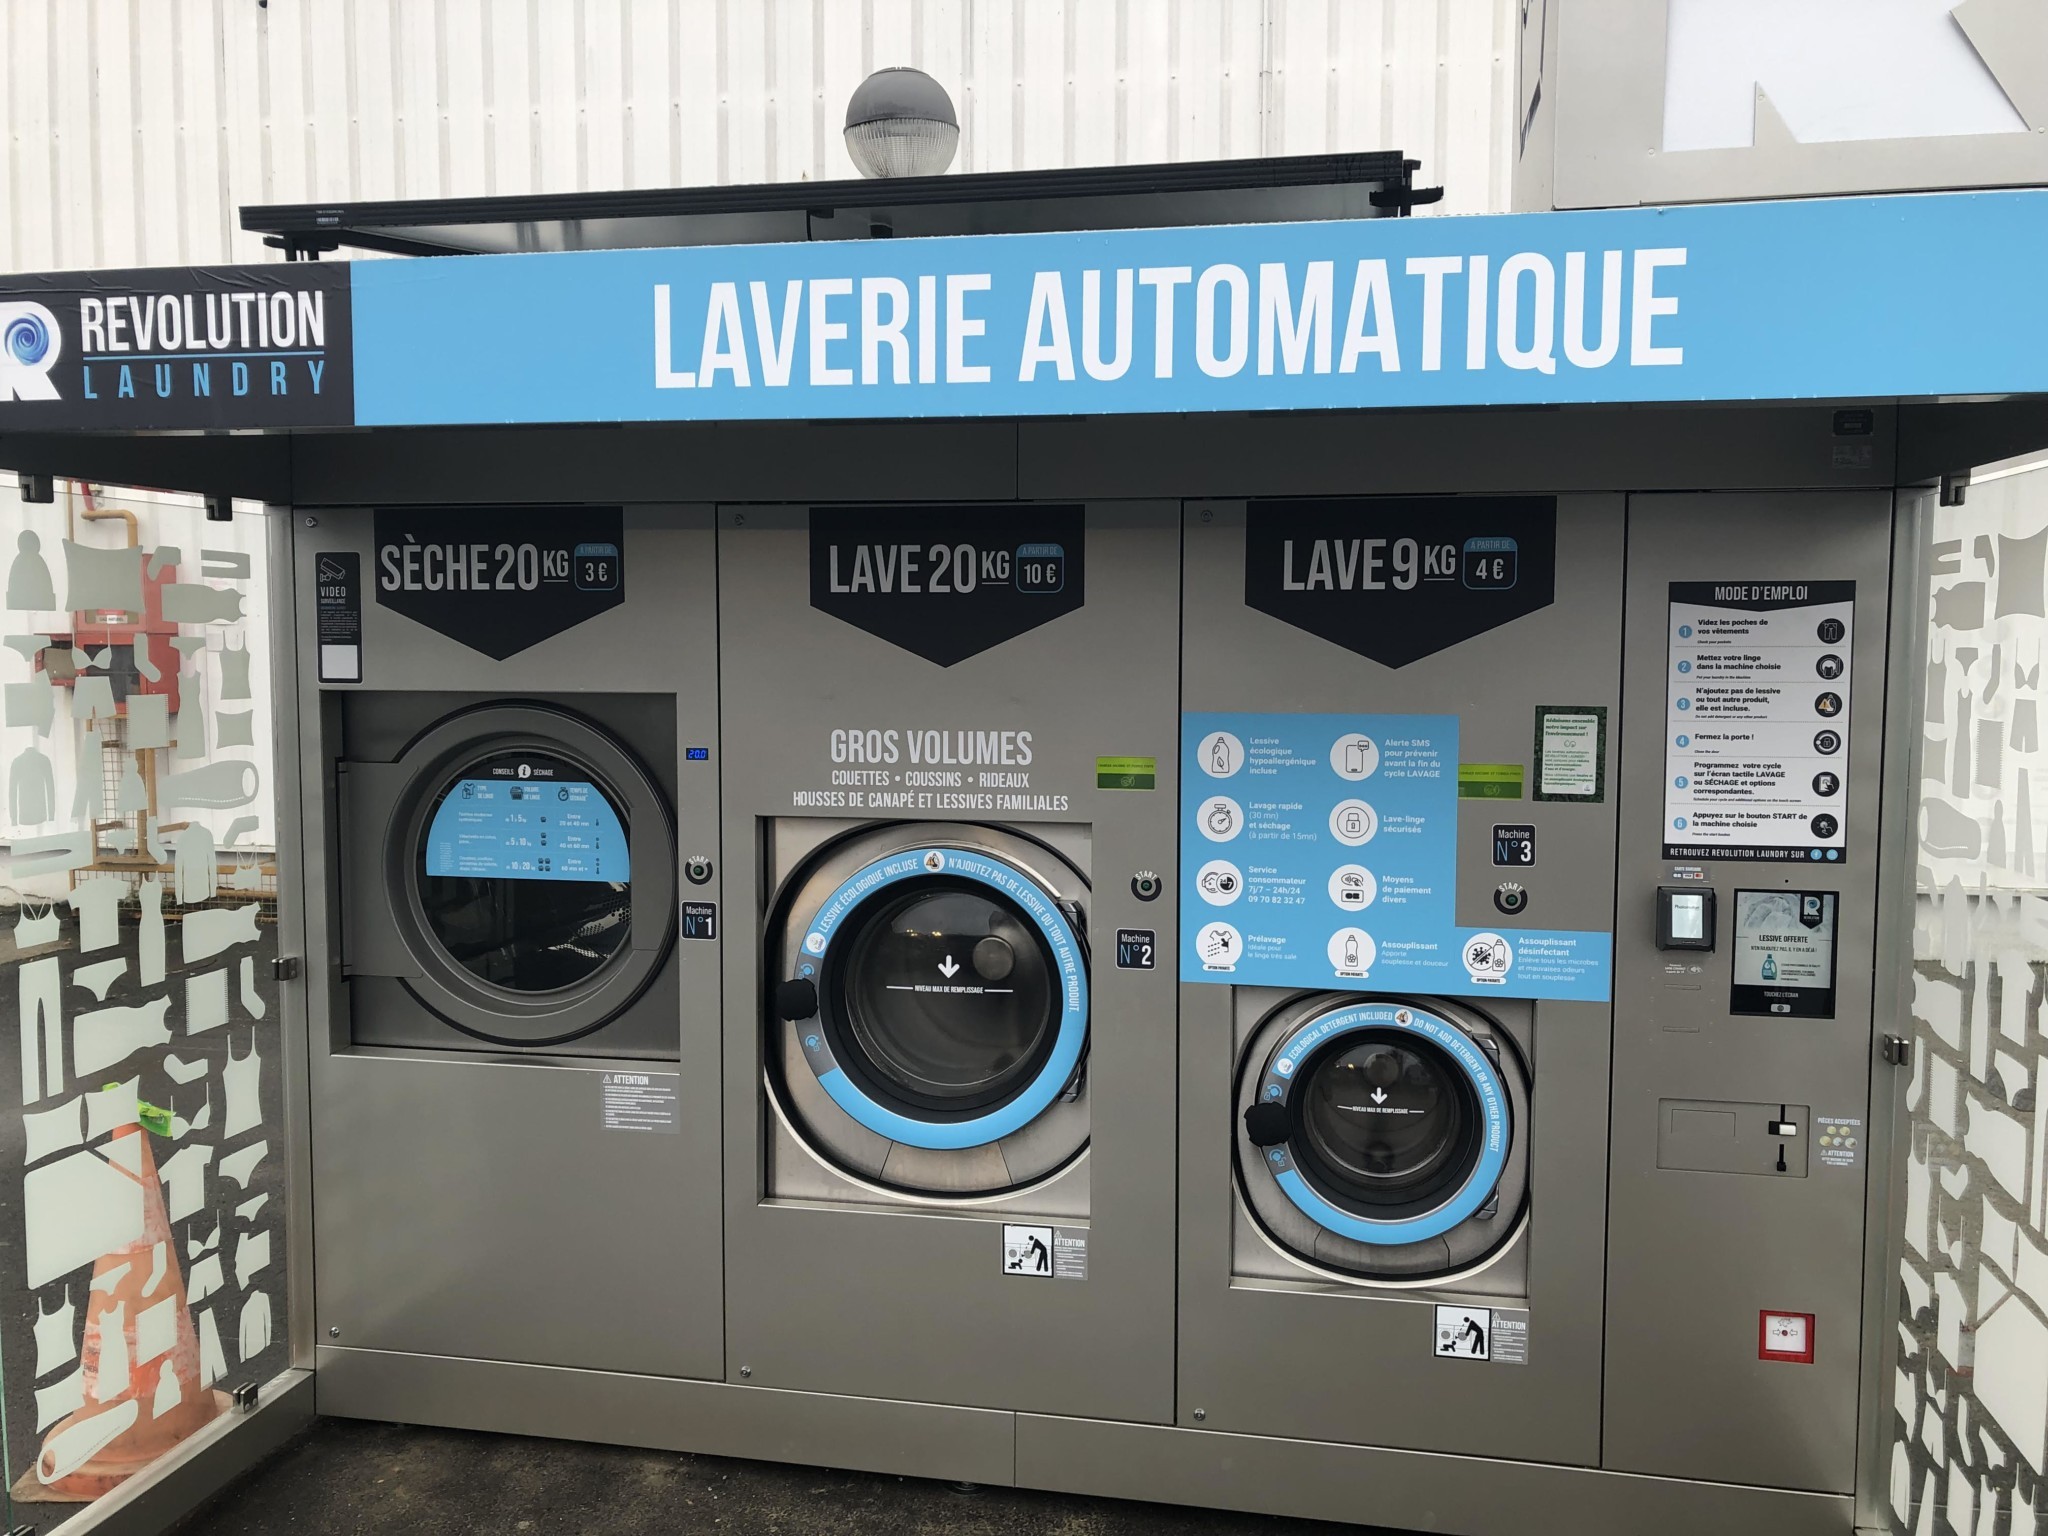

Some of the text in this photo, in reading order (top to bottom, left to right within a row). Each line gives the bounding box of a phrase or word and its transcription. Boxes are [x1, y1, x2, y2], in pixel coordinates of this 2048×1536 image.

[80, 290, 324, 352] REVOLUTION
[653, 248, 1687, 389] LAVERIE AUTOMATIQUE
[83, 360, 325, 399] LAUNDRY
[381, 534, 569, 591] SÈCHE 20 KG
[1283, 538, 1456, 591] LAVE 9 KG
[585, 563, 608, 582] 3 €
[830, 544, 1010, 594] LAVE 20 KG
[1024, 564, 1056, 584] 10 €
[1476, 559, 1504, 580] 4 €
[321, 587, 346, 596] VIDEO
[1714, 585, 1808, 600] MODE D'EMPLOI
[1743, 654, 1761, 662] linge
[1695, 687, 1729, 695] N'ajoutez
[830, 729, 1032, 765] GROS VOLUMES
[1384, 738, 1410, 746] Alerte
[1249, 746, 1292, 756] écologique
[1404, 749, 1438, 758] prévenir
[1249, 757, 1316, 767] hypoallergénique
[1417, 759, 1428, 767] fin
[533, 768, 554, 776] SÉCHAGE
[1383, 769, 1440, 778] cycle LAVAGE
[831, 769, 1029, 788] COUETTES COUSSINS RIDEAUX
[793, 789, 1068, 811] HOUSSES DE CANAPÉ ET LESSIVES FAMILIALES
[1249, 801, 1303, 811] Lavage rapide
[1692, 811, 1723, 820] Appuyez
[1383, 816, 1425, 826] Lave-linge
[1258, 822, 1291, 831] séchage
[1383, 824, 1421, 833] sécurisés
[1498, 829, 1530, 839] Machine
[1669, 847, 1805, 858] RETROUVEZ REVOLUTION LAUNDRY SUR
[689, 856, 709, 865] START
[1248, 865, 1277, 874] Service
[1135, 870, 1158, 881] START
[1382, 875, 1414, 884] Moyens
[1248, 885, 1300, 896] 7j/7 24h/24
[1498, 883, 1523, 892] START
[818, 859, 918, 932] LESSIVE ÉCOLOGIQUE INCLUSE
[1260, 895, 1270, 903] 70
[1271, 896, 1282, 904] 82
[1382, 895, 1406, 903] divers
[686, 906, 712, 915] Machine
[949, 858, 1080, 1012] N'AJOUTEZ PAS DE LESSIVE OU TOUT AUTRE PRODUIT.
[1121, 934, 1151, 944] Machine
[1247, 934, 1286, 946] Prélavage
[1381, 940, 1438, 951] Assouplissant
[1518, 936, 1576, 948] Assouplissant
[1518, 946, 1569, 956] désinfectant
[1288, 1012, 1392, 1059] ECOLOGICAL DETERGENT INCLUDED
[613, 1075, 649, 1085] ATTENTION
[1054, 1238, 1085, 1247] ATTENTION
[1492, 1320, 1526, 1330] ATTENTION
